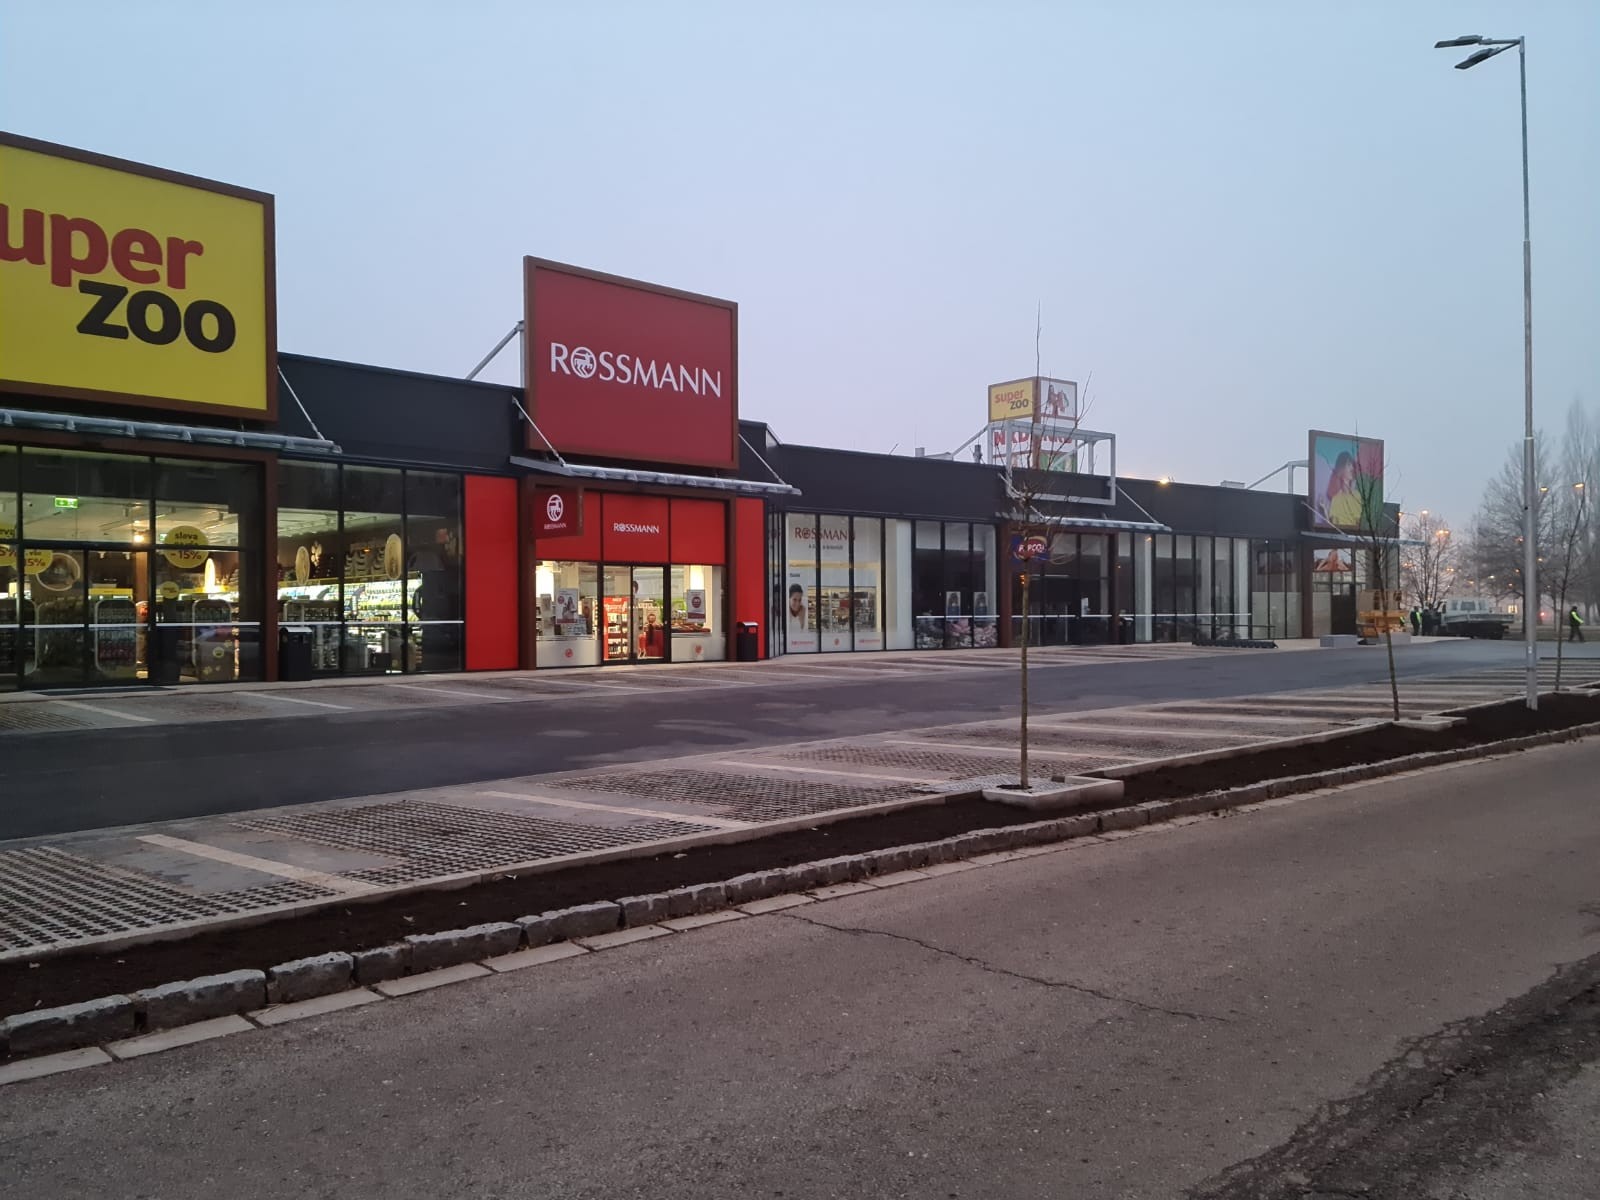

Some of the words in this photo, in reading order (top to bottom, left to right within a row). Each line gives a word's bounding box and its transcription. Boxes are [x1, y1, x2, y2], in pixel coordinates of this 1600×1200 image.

[76, 279, 236, 354] zoo
[550, 342, 721, 398] ROSSMANN
[994, 389, 1024, 403] super
[1010, 398, 1029, 410] zoo
[613, 522, 660, 534] ROSSMANN
[795, 526, 855, 541] ROSMAN
[175, 531, 198, 540] sleva
